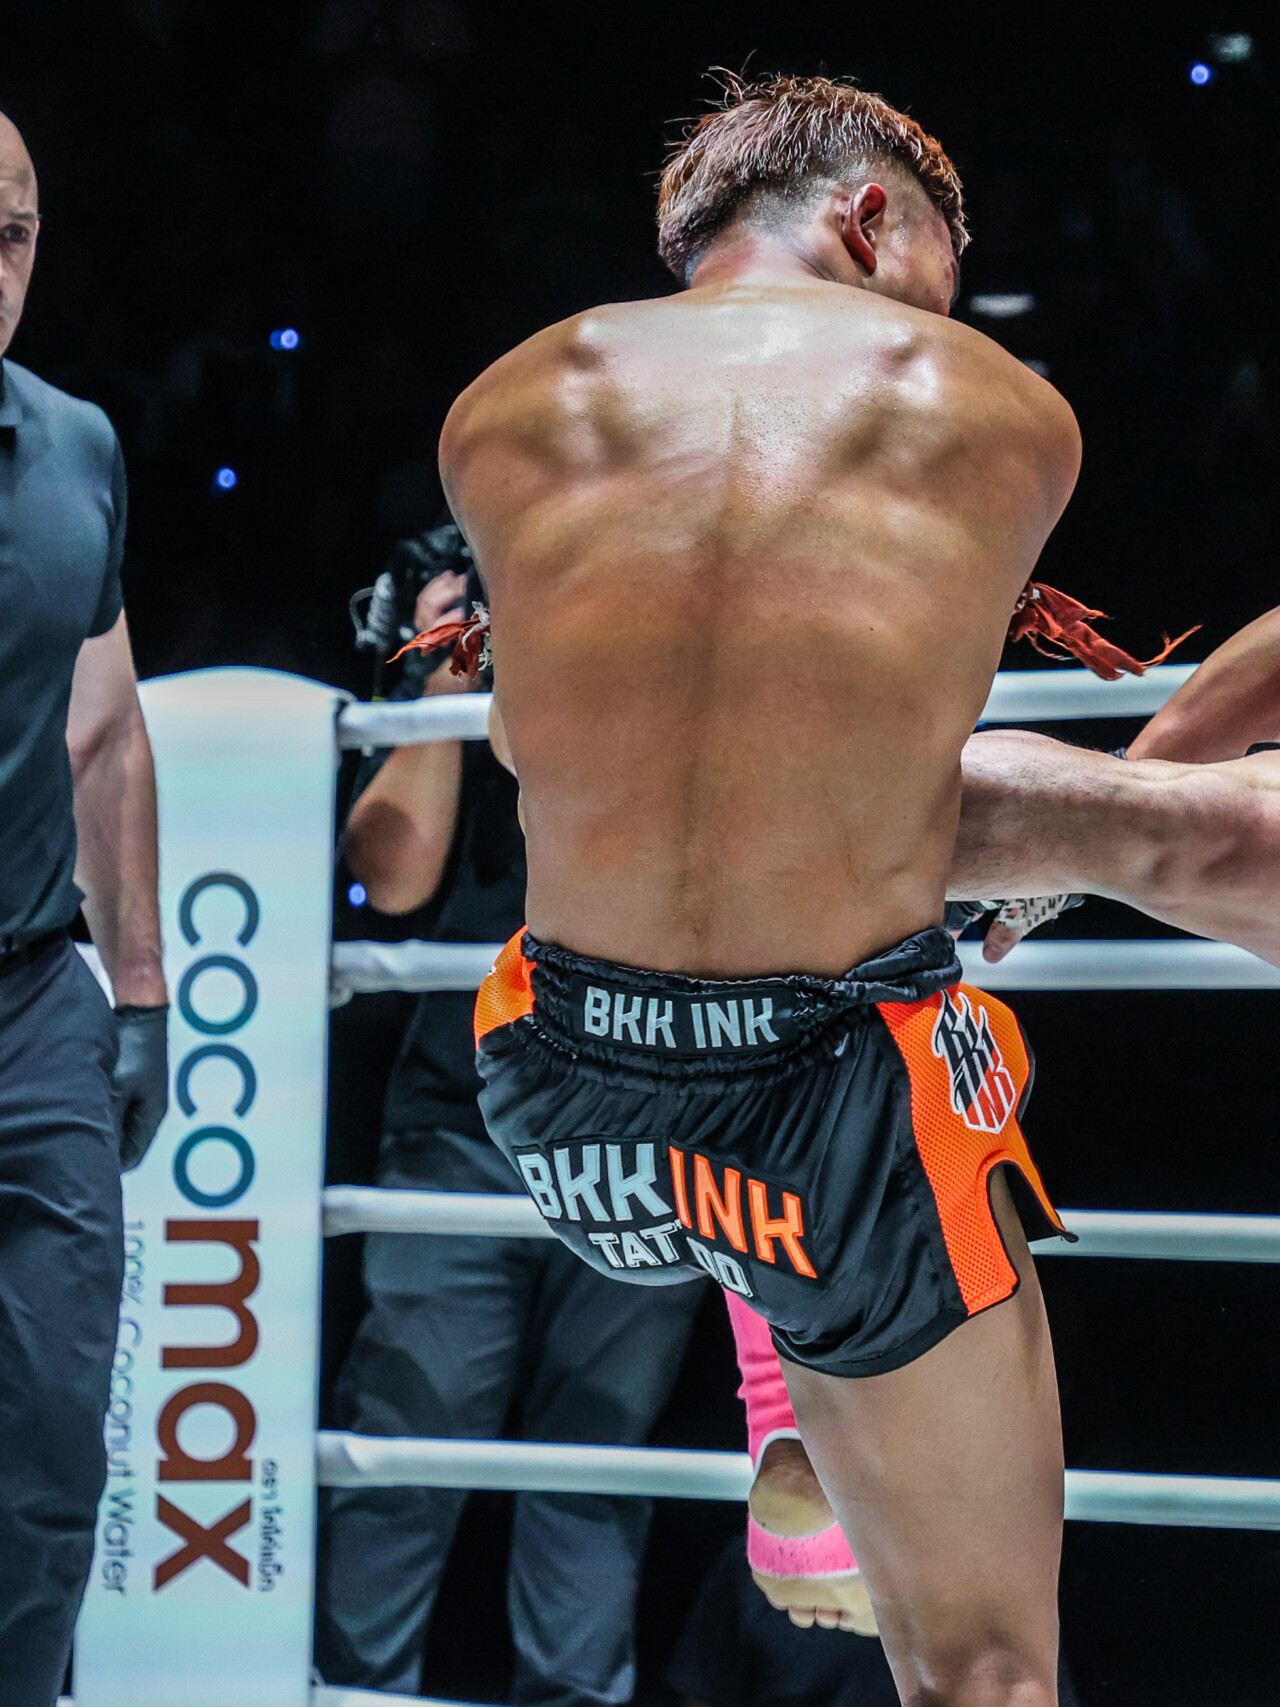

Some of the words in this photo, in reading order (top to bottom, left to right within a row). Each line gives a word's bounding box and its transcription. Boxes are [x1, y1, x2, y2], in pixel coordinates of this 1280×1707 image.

[584, 986, 677, 1048] BKK
[691, 998, 780, 1049] INK
[153, 872, 261, 1593] cocomax
[517, 1143, 673, 1222] BKK
[669, 1146, 818, 1279] INK
[588, 1219, 754, 1298] TATOO
[108, 1317, 142, 1478] Coconut
[101, 1487, 137, 1596] Water
